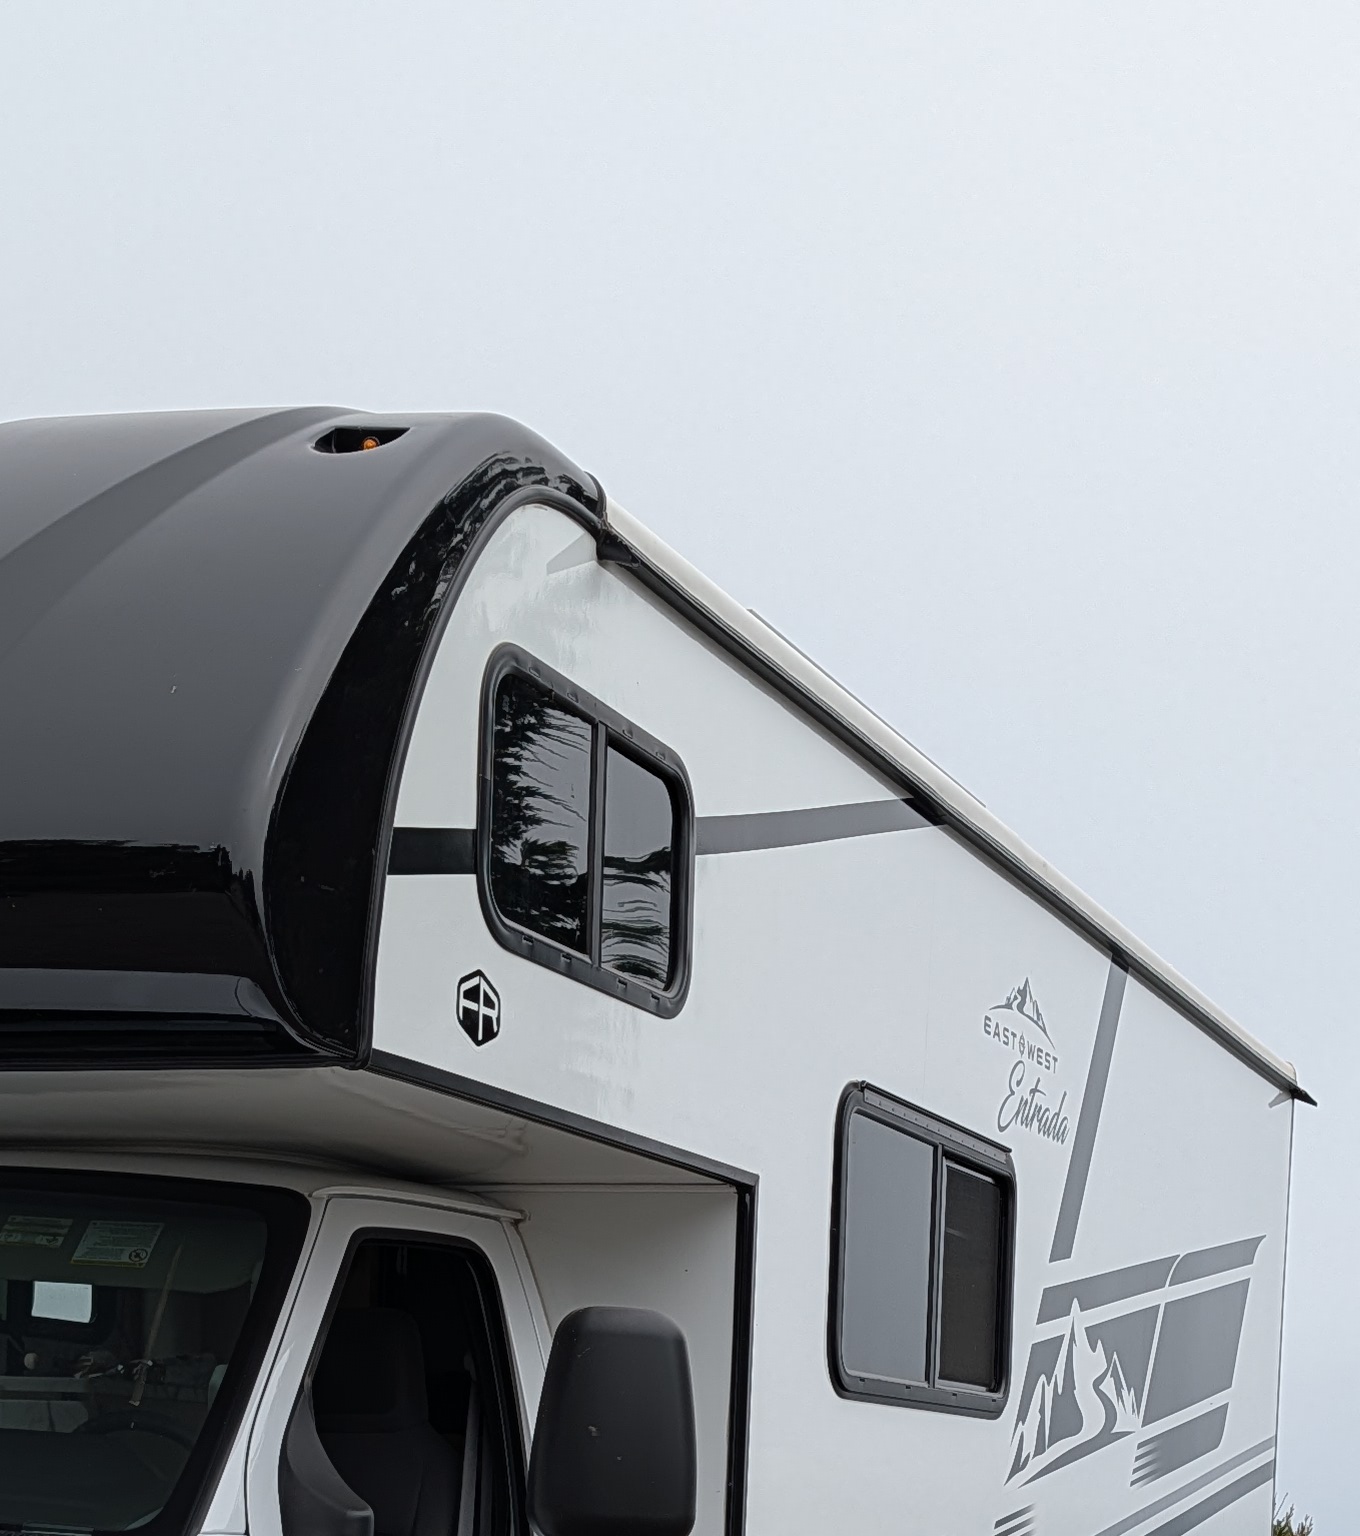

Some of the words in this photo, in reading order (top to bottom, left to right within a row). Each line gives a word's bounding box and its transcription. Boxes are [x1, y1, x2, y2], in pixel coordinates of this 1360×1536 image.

[982, 1014, 1018, 1051] EAST
[1026, 1040, 1059, 1075] WEST
[997, 1059, 1071, 1146] Entrada
